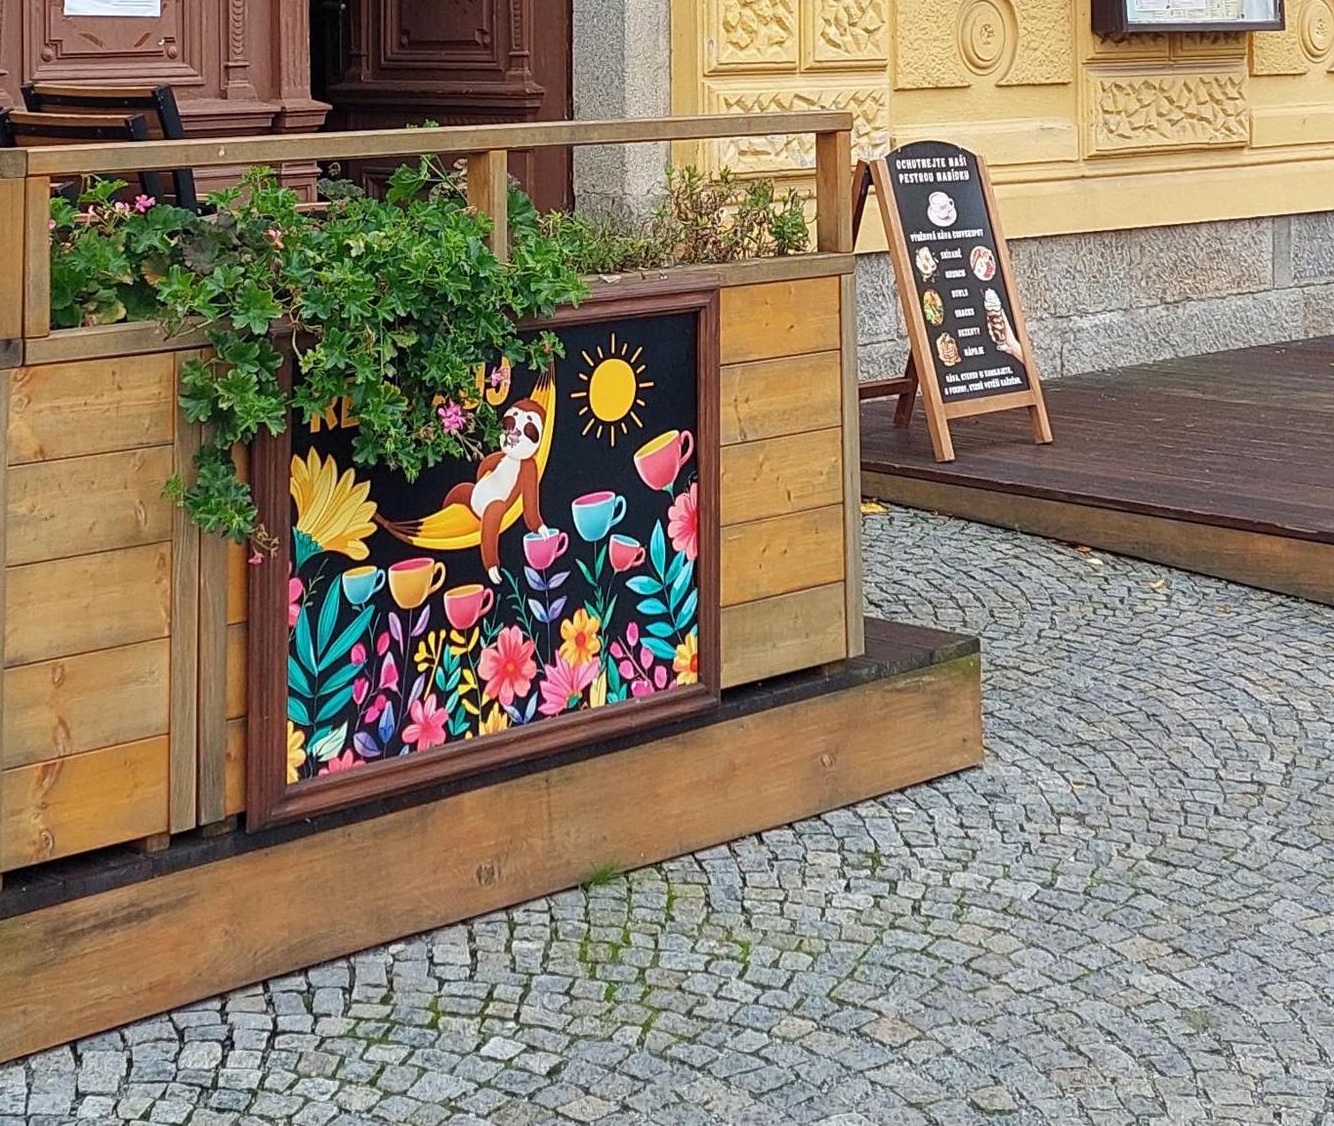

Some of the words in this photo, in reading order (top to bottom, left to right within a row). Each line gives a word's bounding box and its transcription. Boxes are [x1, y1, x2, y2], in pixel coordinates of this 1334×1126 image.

[948, 154, 967, 167] NAŠI
[898, 172, 934, 184] PESTROU
[936, 169, 970, 182] NABÍDKU
